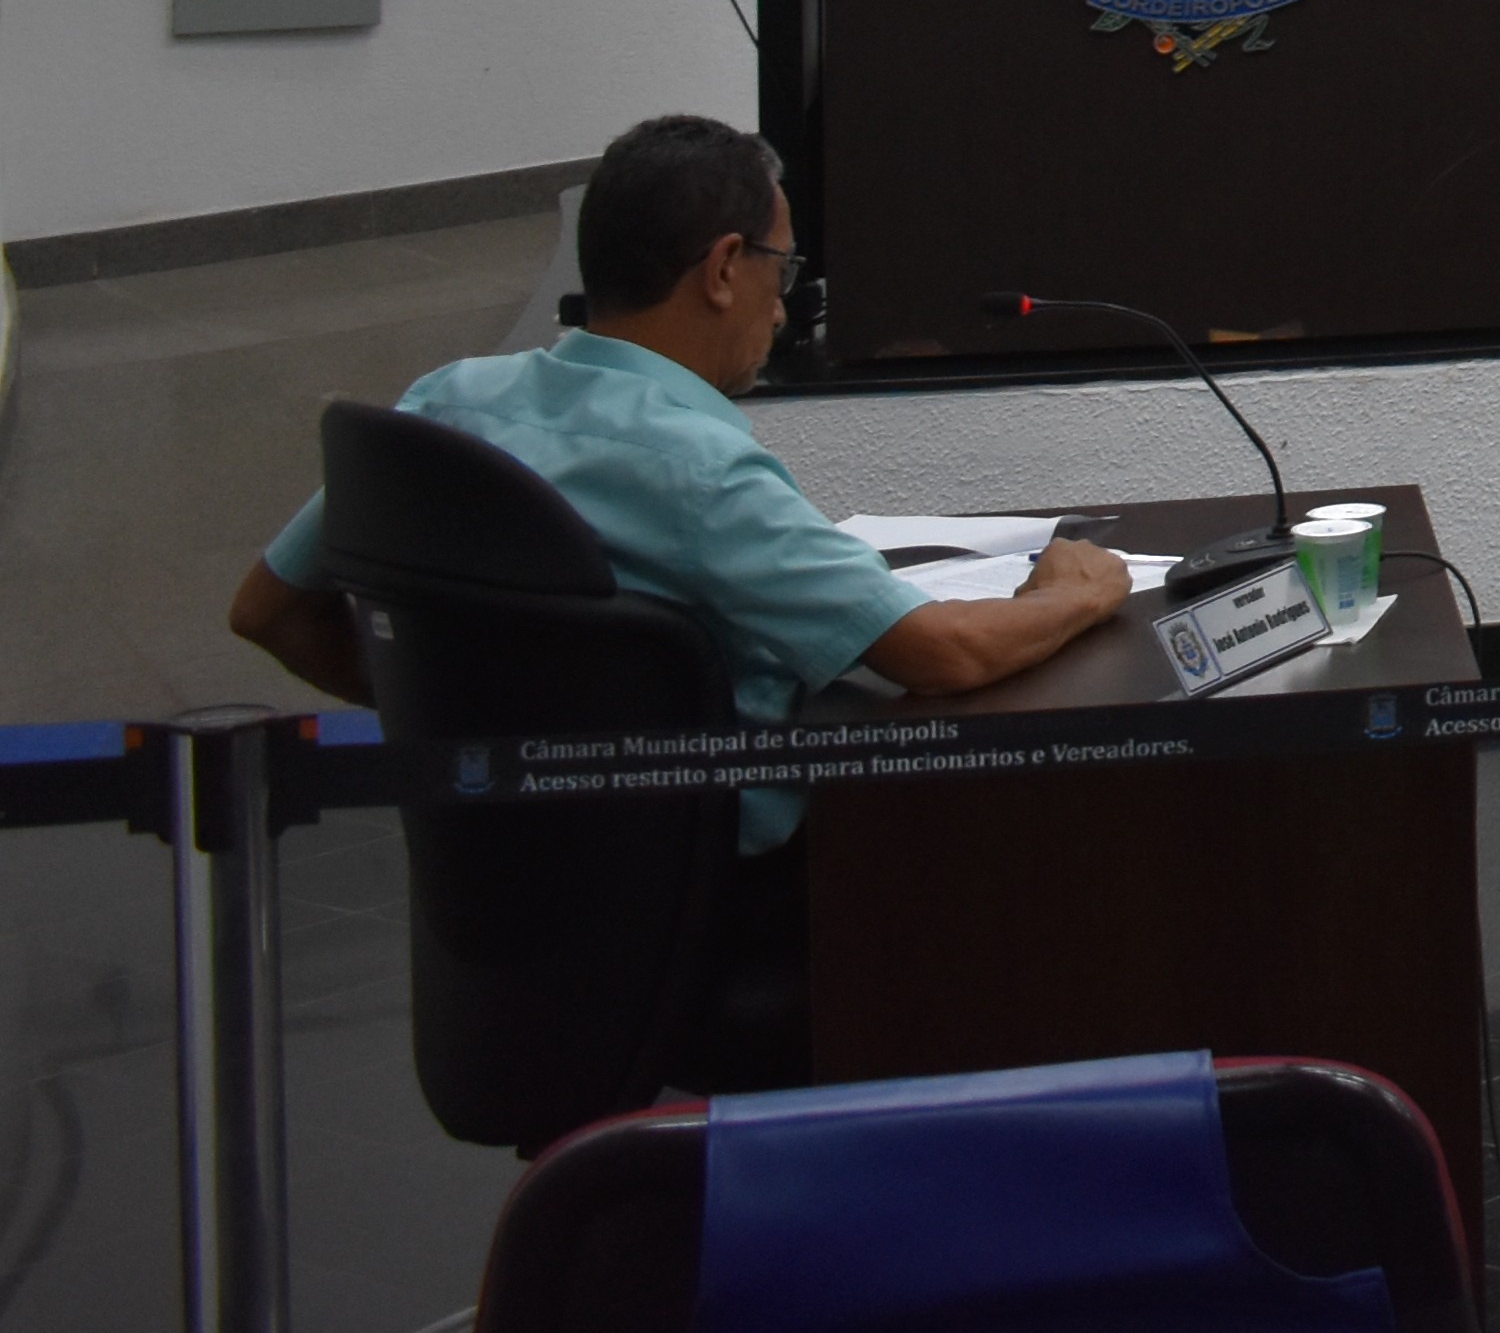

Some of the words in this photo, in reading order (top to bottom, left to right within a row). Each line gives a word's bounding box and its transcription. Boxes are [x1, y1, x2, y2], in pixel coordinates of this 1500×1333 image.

[1212, 631, 1237, 654] José
[1265, 600, 1311, 630] Rodrigues
[519, 770, 606, 795] Acesso
[611, 763, 709, 789] restrito
[713, 762, 803, 790] apenas
[807, 758, 866, 785] para
[869, 744, 1028, 777] funcionários
[1031, 748, 1047, 764] e
[1051, 733, 1196, 764] Vereadores.
[520, 736, 617, 763] Câmara
[622, 731, 749, 760] Municipal
[753, 731, 785, 753] de
[789, 718, 959, 753] Cordeirópolis
